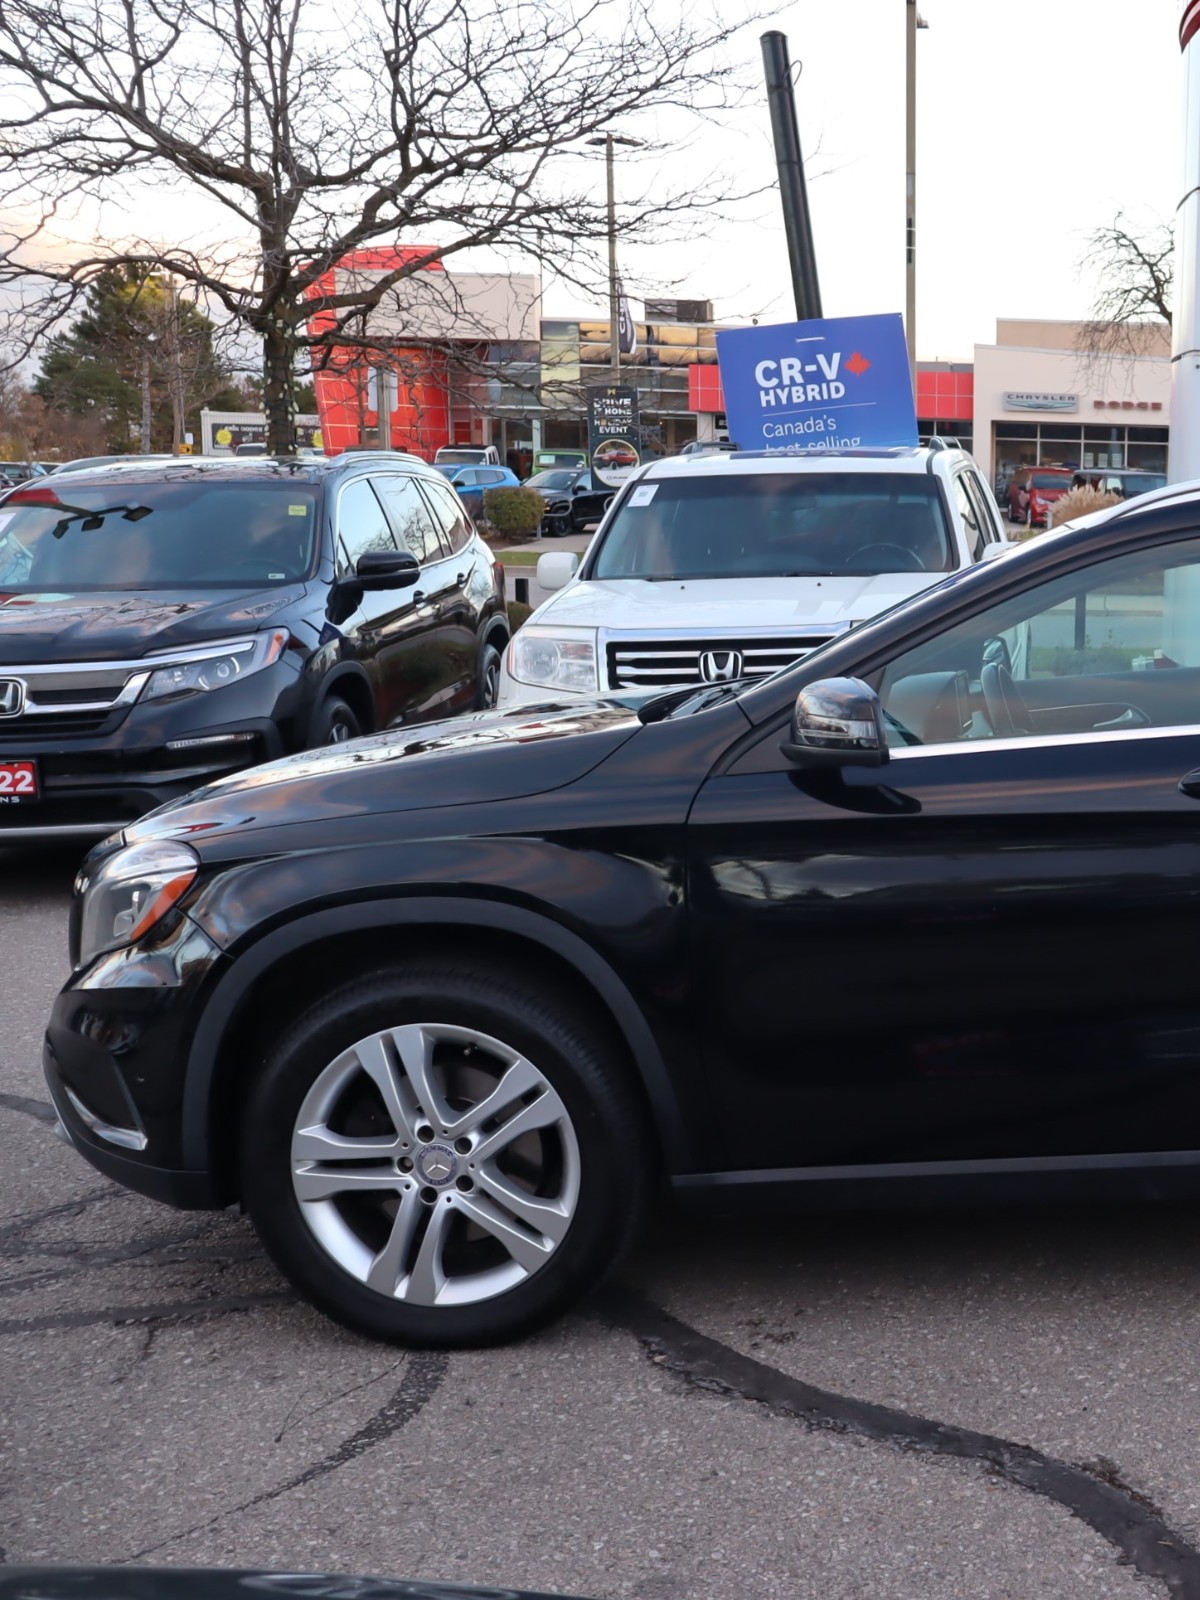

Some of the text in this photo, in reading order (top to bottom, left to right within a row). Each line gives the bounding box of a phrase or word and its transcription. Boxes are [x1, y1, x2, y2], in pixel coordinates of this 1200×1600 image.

[755, 352, 841, 388] CR-V
[760, 381, 845, 407] HYBRID
[1093, 400, 1162, 411] DODGE
[599, 426, 628, 434] EVENT
[762, 414, 837, 438] Canada's
